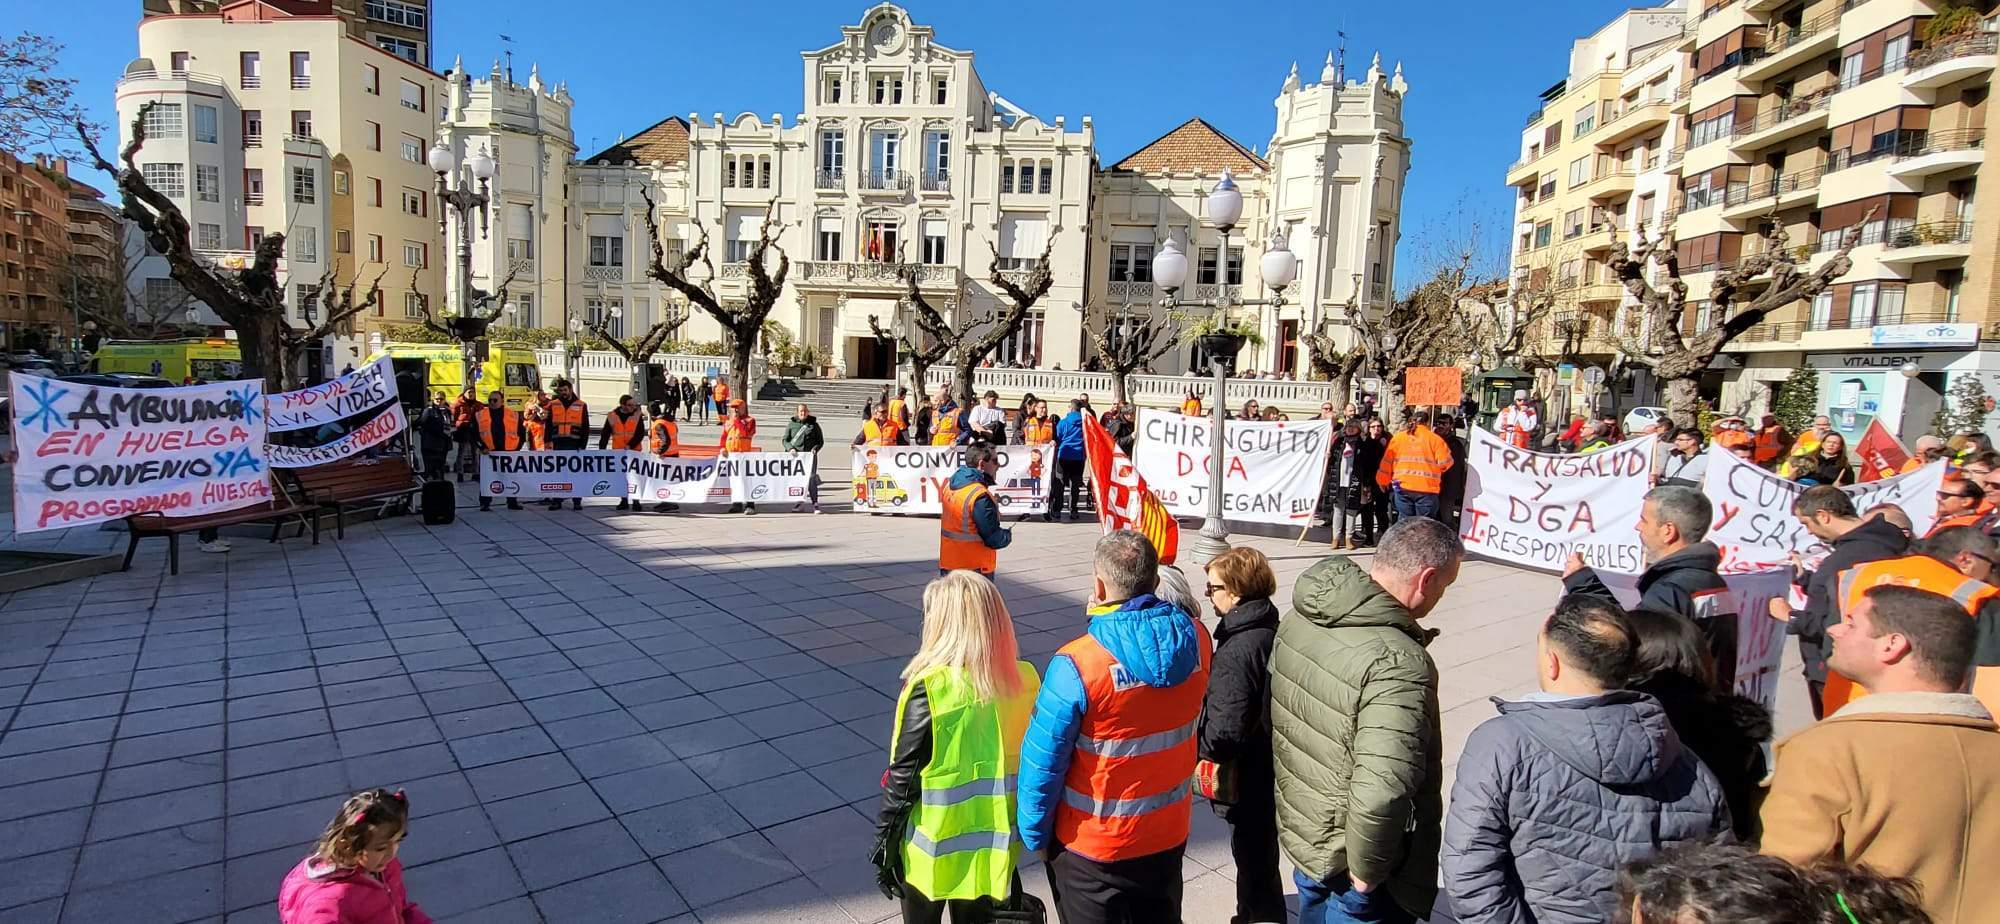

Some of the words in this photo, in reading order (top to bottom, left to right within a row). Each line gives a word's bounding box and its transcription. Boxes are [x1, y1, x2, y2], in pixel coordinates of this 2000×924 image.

[1843, 356, 1924, 367] VITALDENT
[326, 382, 385, 416] VIDAS
[36, 431, 105, 457] EN
[117, 425, 249, 457] HUELGA
[43, 458, 211, 491] CONVENIO
[213, 446, 260, 478] YA
[489, 455, 616, 473] TRANSPORTE
[621, 455, 713, 482] SANITARIO
[718, 460, 739, 477] EN
[745, 460, 806, 477] LUCHA
[894, 451, 1010, 468] CONVEO
[1480, 439, 1646, 477] TRANSALUD
[37, 491, 193, 528] PROGRAMADO
[1188, 486, 1282, 513] JEGAN
[1509, 496, 1596, 533] DGA
